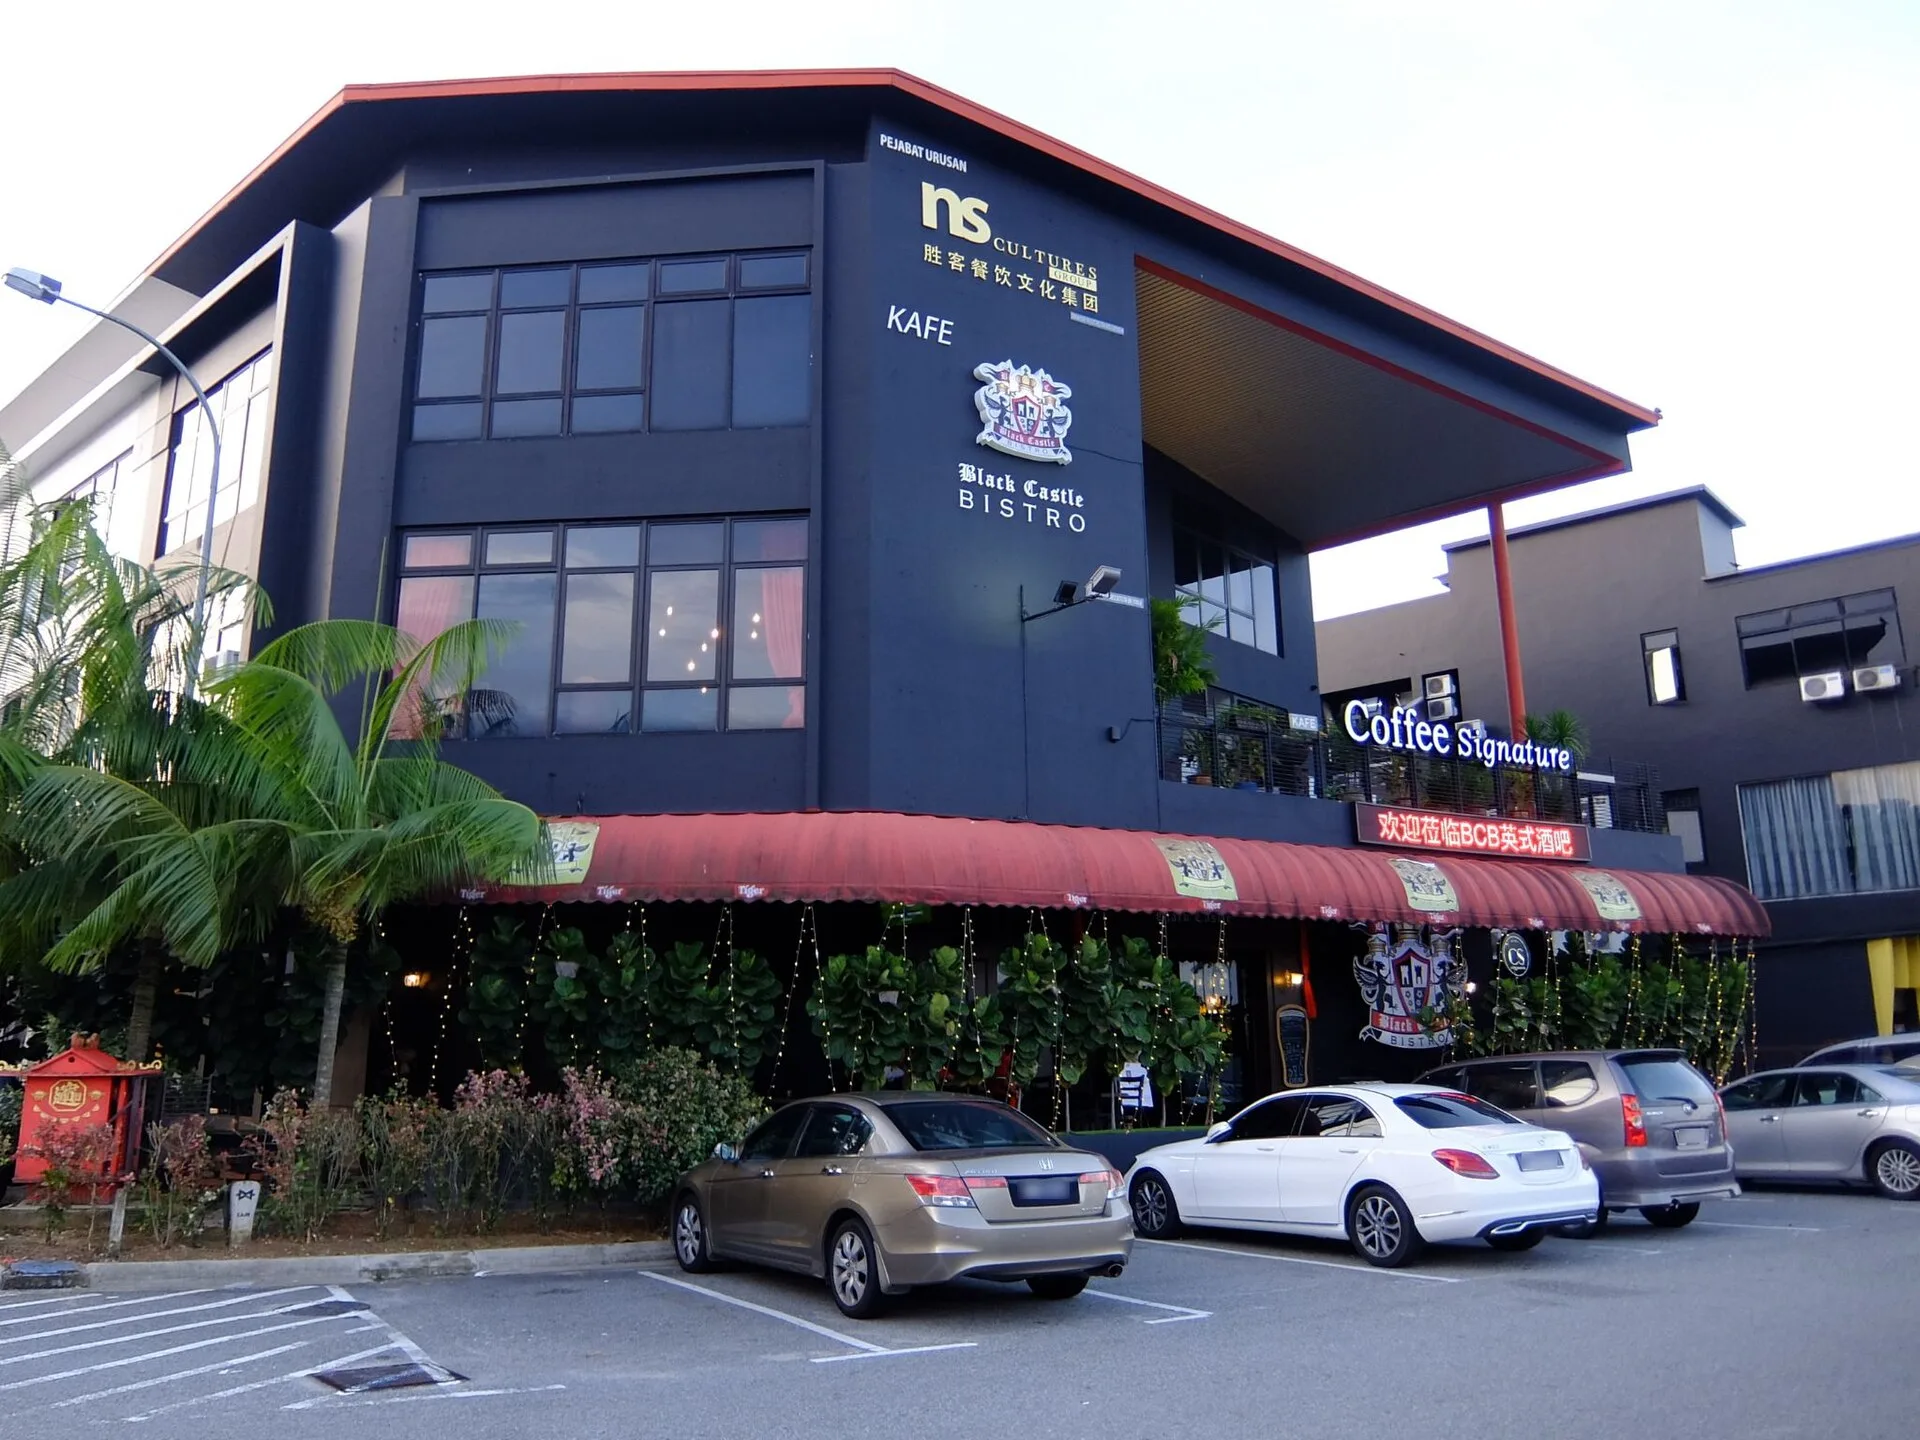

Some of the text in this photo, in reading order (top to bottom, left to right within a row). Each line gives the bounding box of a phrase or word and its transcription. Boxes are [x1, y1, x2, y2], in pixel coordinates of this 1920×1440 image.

[880, 134, 967, 173] PEJABAT URUSAN
[921, 181, 1097, 280] ns CULTURES
[924, 243, 1098, 313] 胜客餐饮文化集团
[1053, 269, 1093, 289] GROUP
[887, 305, 954, 345] KAFE
[958, 463, 1084, 508] Black Castle
[959, 489, 1086, 533] BISTRO
[1292, 715, 1317, 729] KAFE
[1344, 700, 1570, 770] Coffee Signature
[1377, 811, 1574, 855] 欢迎莅临BCB英式酒吧
[738, 884, 765, 898] Tiger
